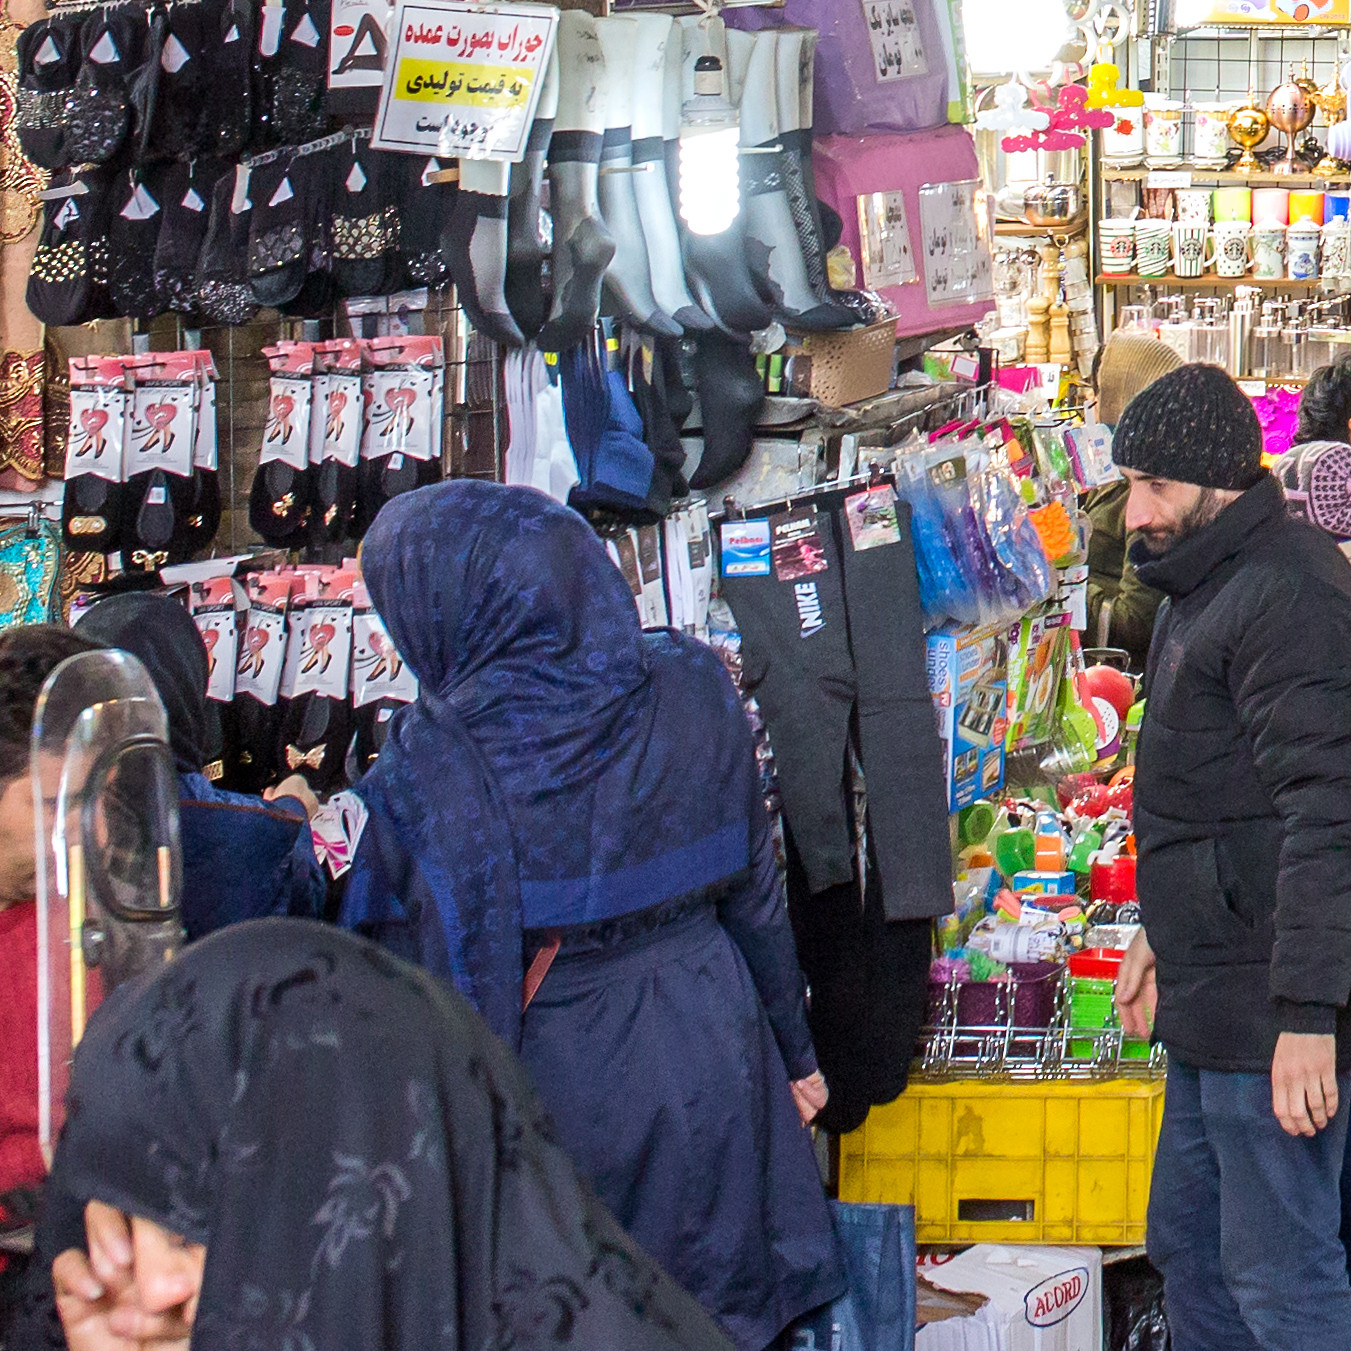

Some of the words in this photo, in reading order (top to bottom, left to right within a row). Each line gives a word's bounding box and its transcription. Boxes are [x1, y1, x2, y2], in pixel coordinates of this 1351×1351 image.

[404, 22, 443, 45] عمده
[446, 24, 494, 58] بصورت
[497, 23, 543, 62] جوراب
[406, 70, 464, 97] تولیدی
[466, 75, 505, 100] قیمت
[508, 78, 523, 102] به
[416, 113, 449, 132] است
[795, 582, 823, 628] NIKE
[938, 641, 950, 686] shoes
[1034, 1276, 1081, 1317] ACORD
